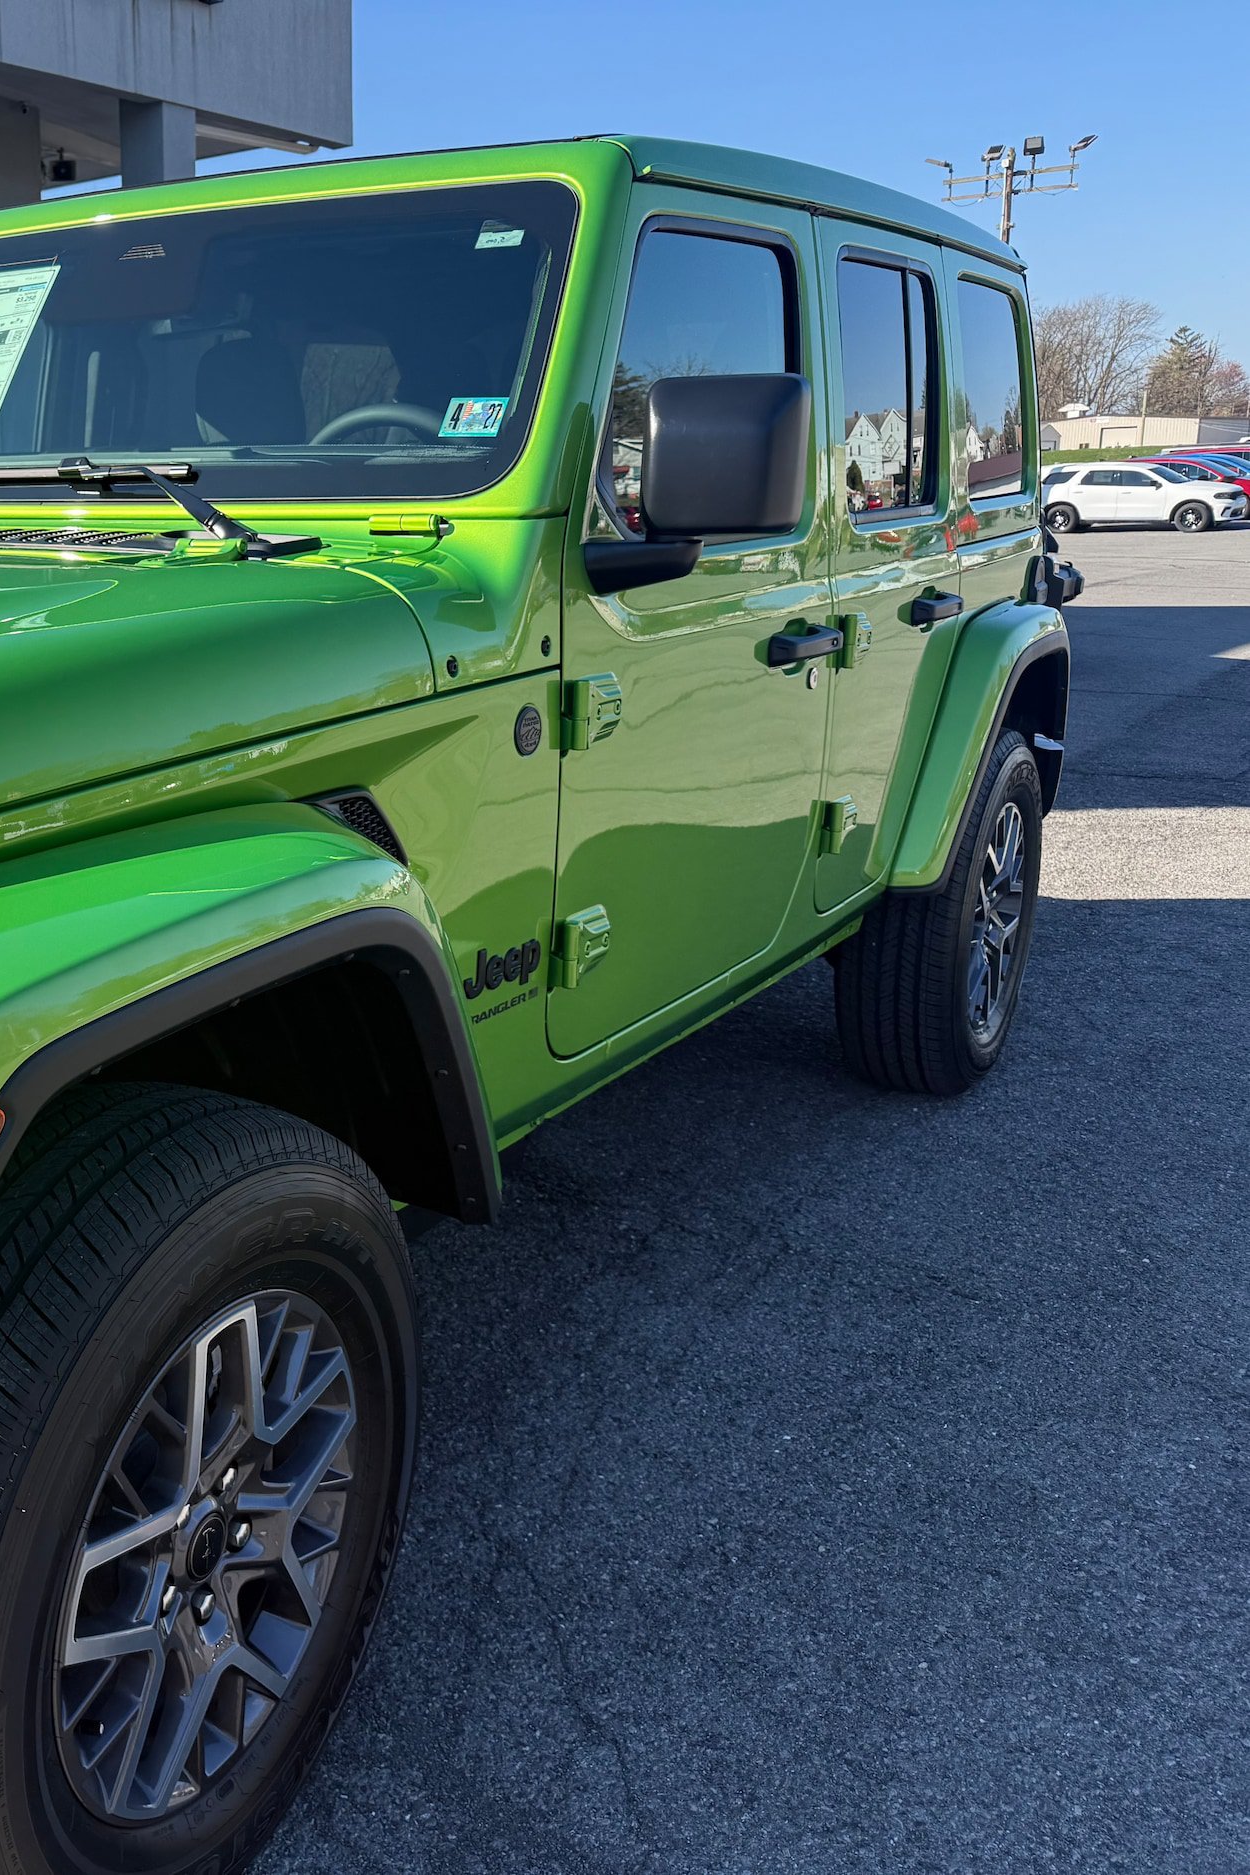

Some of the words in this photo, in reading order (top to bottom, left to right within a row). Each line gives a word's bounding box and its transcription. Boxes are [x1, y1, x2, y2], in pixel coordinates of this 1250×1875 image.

[449, 403, 464, 430] 4
[483, 403, 503, 429] 27
[463, 938, 541, 1000] Jeep
[471, 993, 526, 1025] RANGLER
